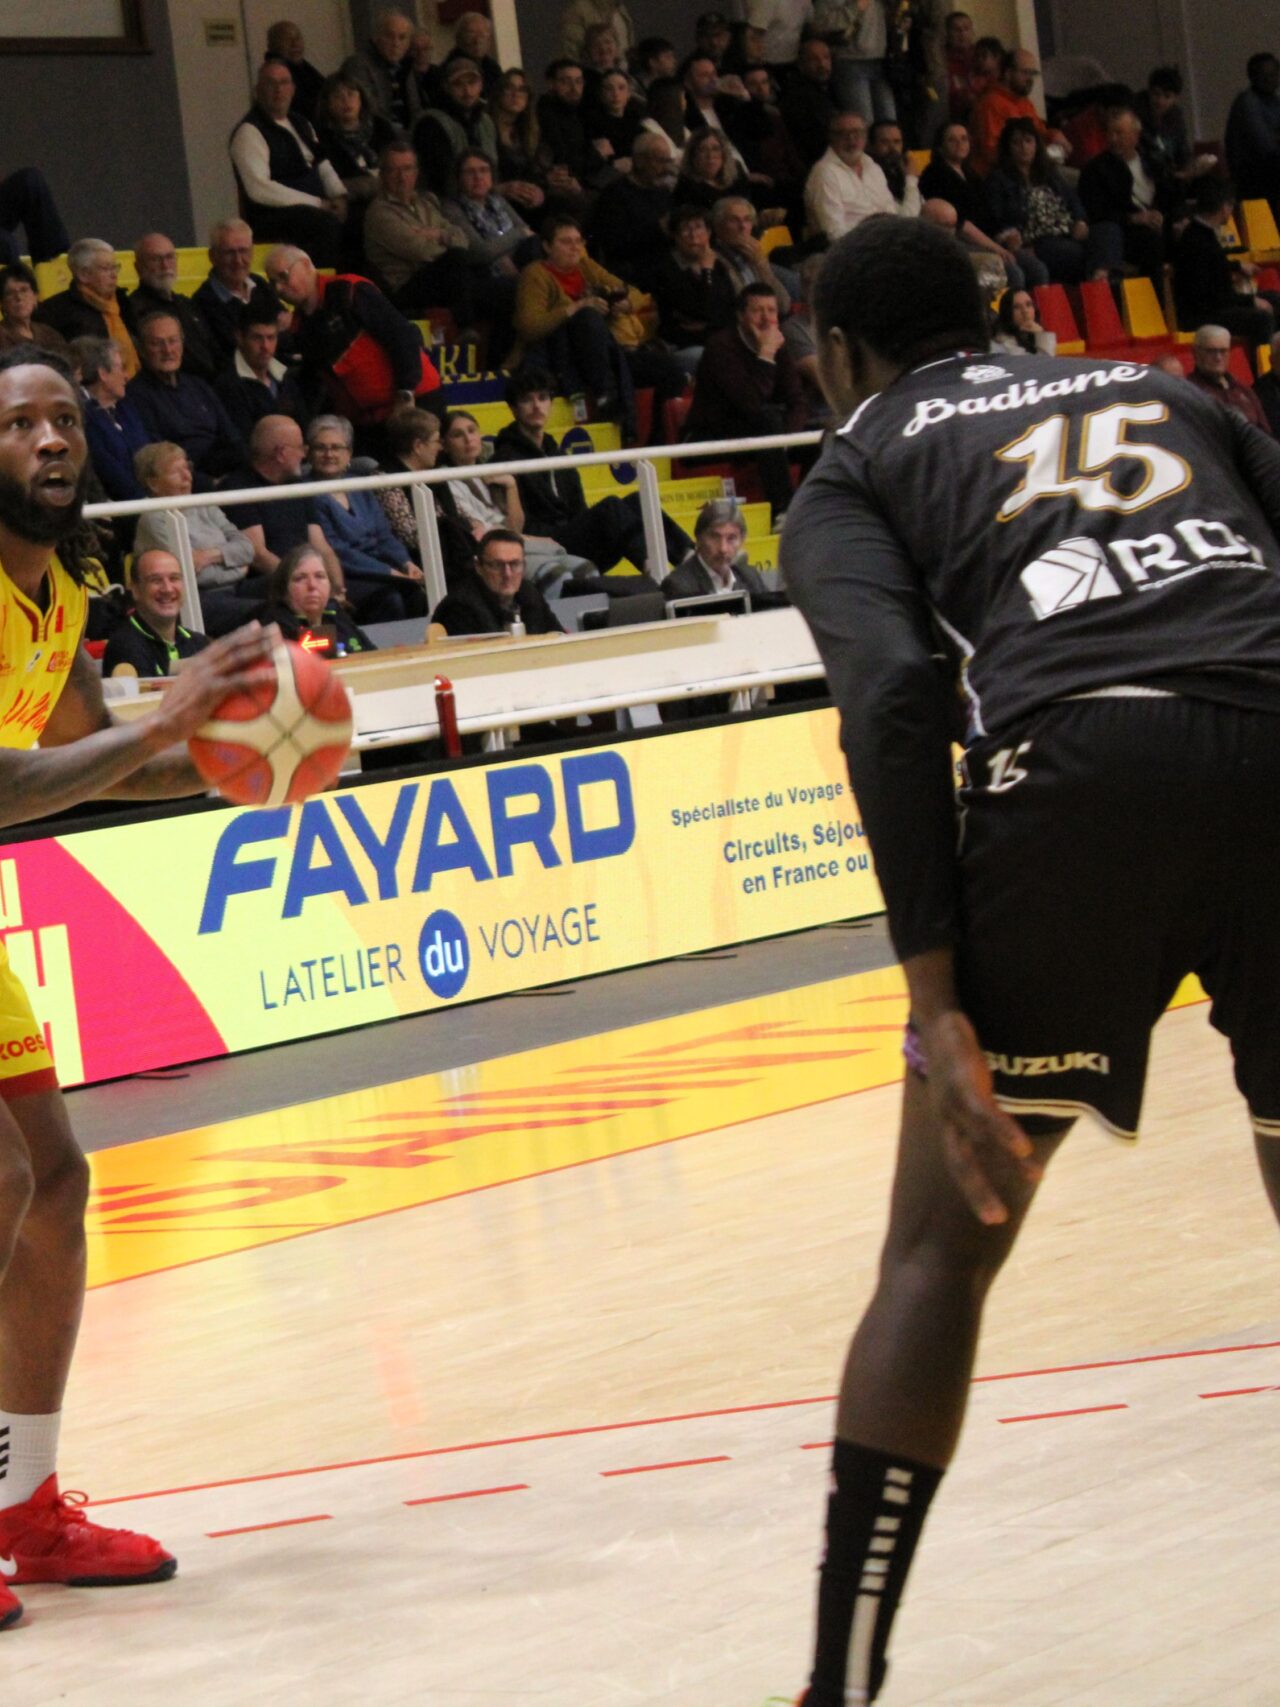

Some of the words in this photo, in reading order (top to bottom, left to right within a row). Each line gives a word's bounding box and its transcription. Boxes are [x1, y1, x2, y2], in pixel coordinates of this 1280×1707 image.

[902, 363, 1149, 437] Badiane
[994, 400, 1193, 523] 15
[765, 789, 784, 809] du
[788, 781, 844, 806] Voyage
[197, 750, 636, 936] FAYARD
[813, 819, 867, 849] Séjou
[743, 874, 767, 894] en
[773, 860, 840, 889] France
[846, 853, 869, 873] ou
[425, 930, 464, 978] du
[479, 903, 601, 960] VOYAGE
